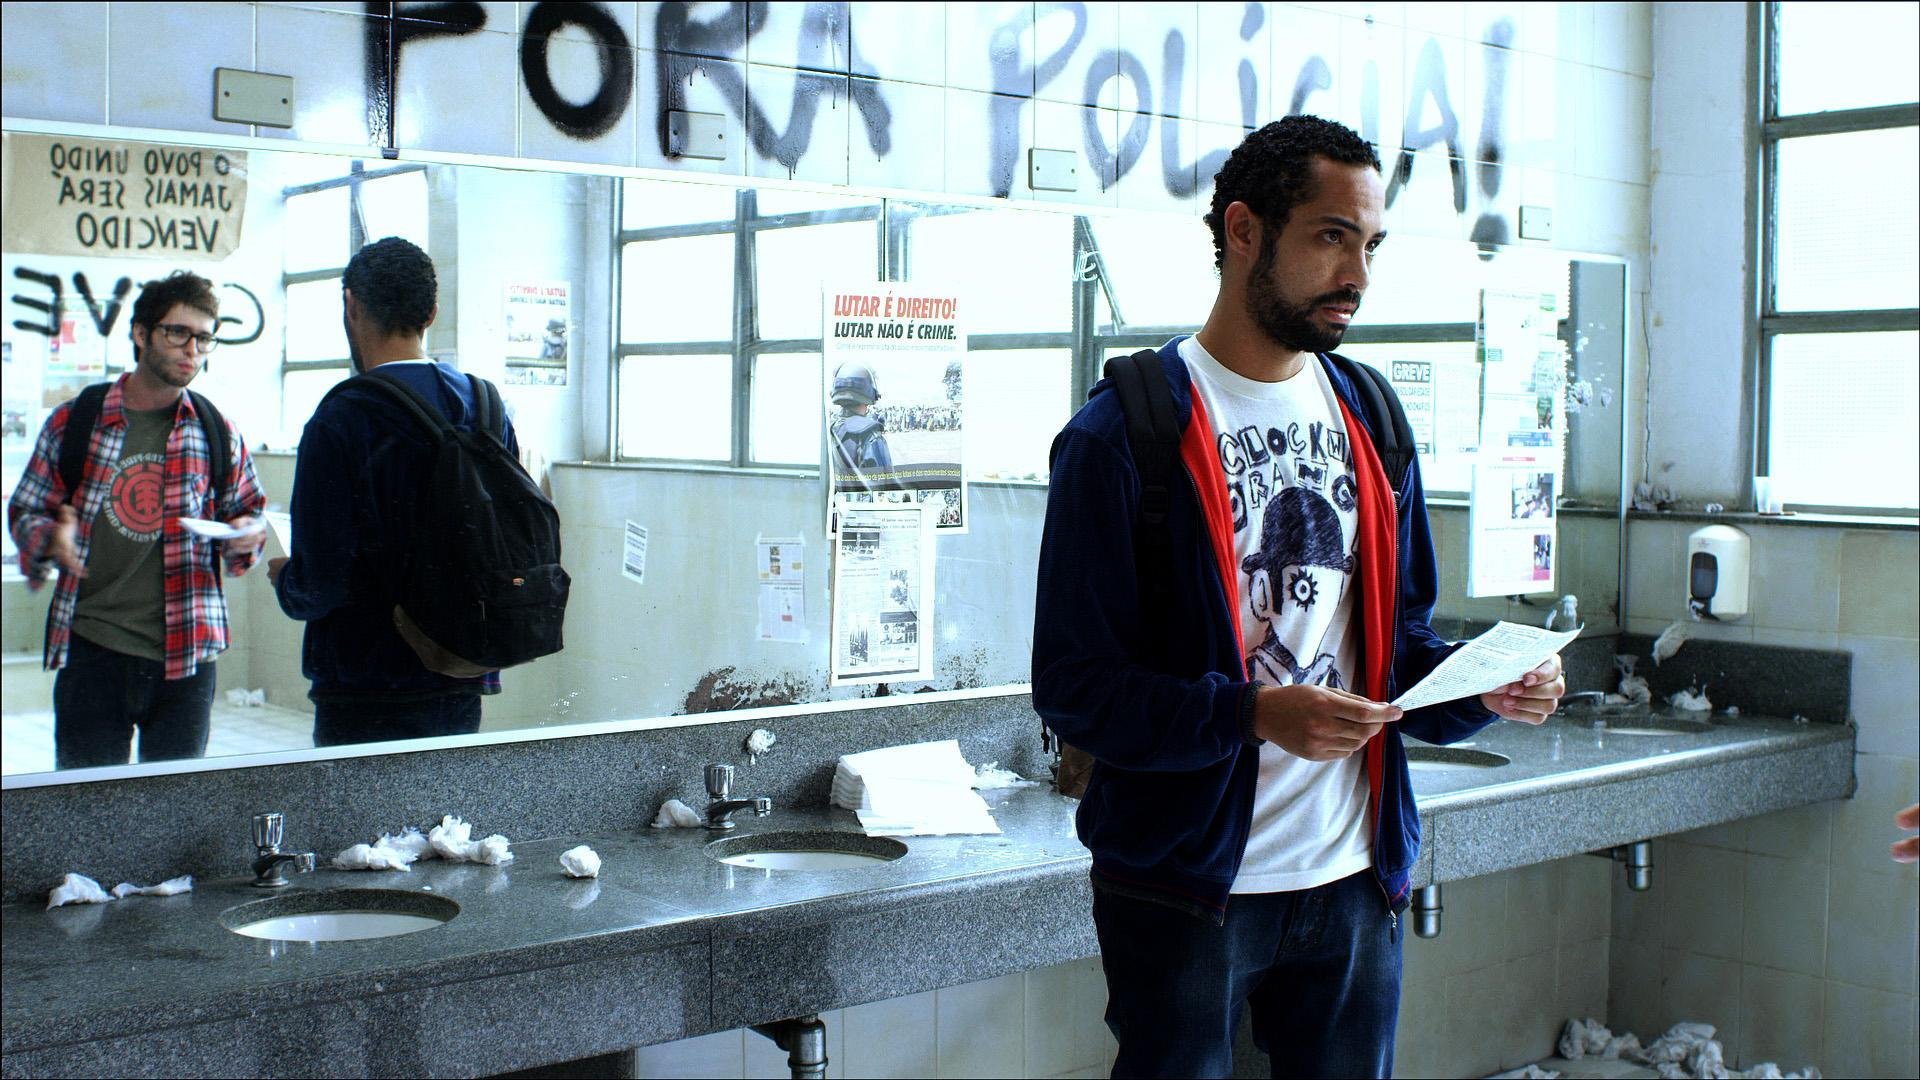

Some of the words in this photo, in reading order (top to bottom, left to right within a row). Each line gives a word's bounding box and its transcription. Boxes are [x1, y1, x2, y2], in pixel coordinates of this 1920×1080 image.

[834, 294, 880, 317] LUTAR
[884, 290, 893, 318] É
[897, 297, 957, 319] DIREITO!
[834, 322, 874, 338] LUTAR
[877, 319, 904, 339] NÃO
[907, 320, 915, 339] É
[917, 324, 957, 340] CRIME.
[1393, 363, 1430, 381] GREVE
[1217, 421, 1354, 476] CLOCKW
